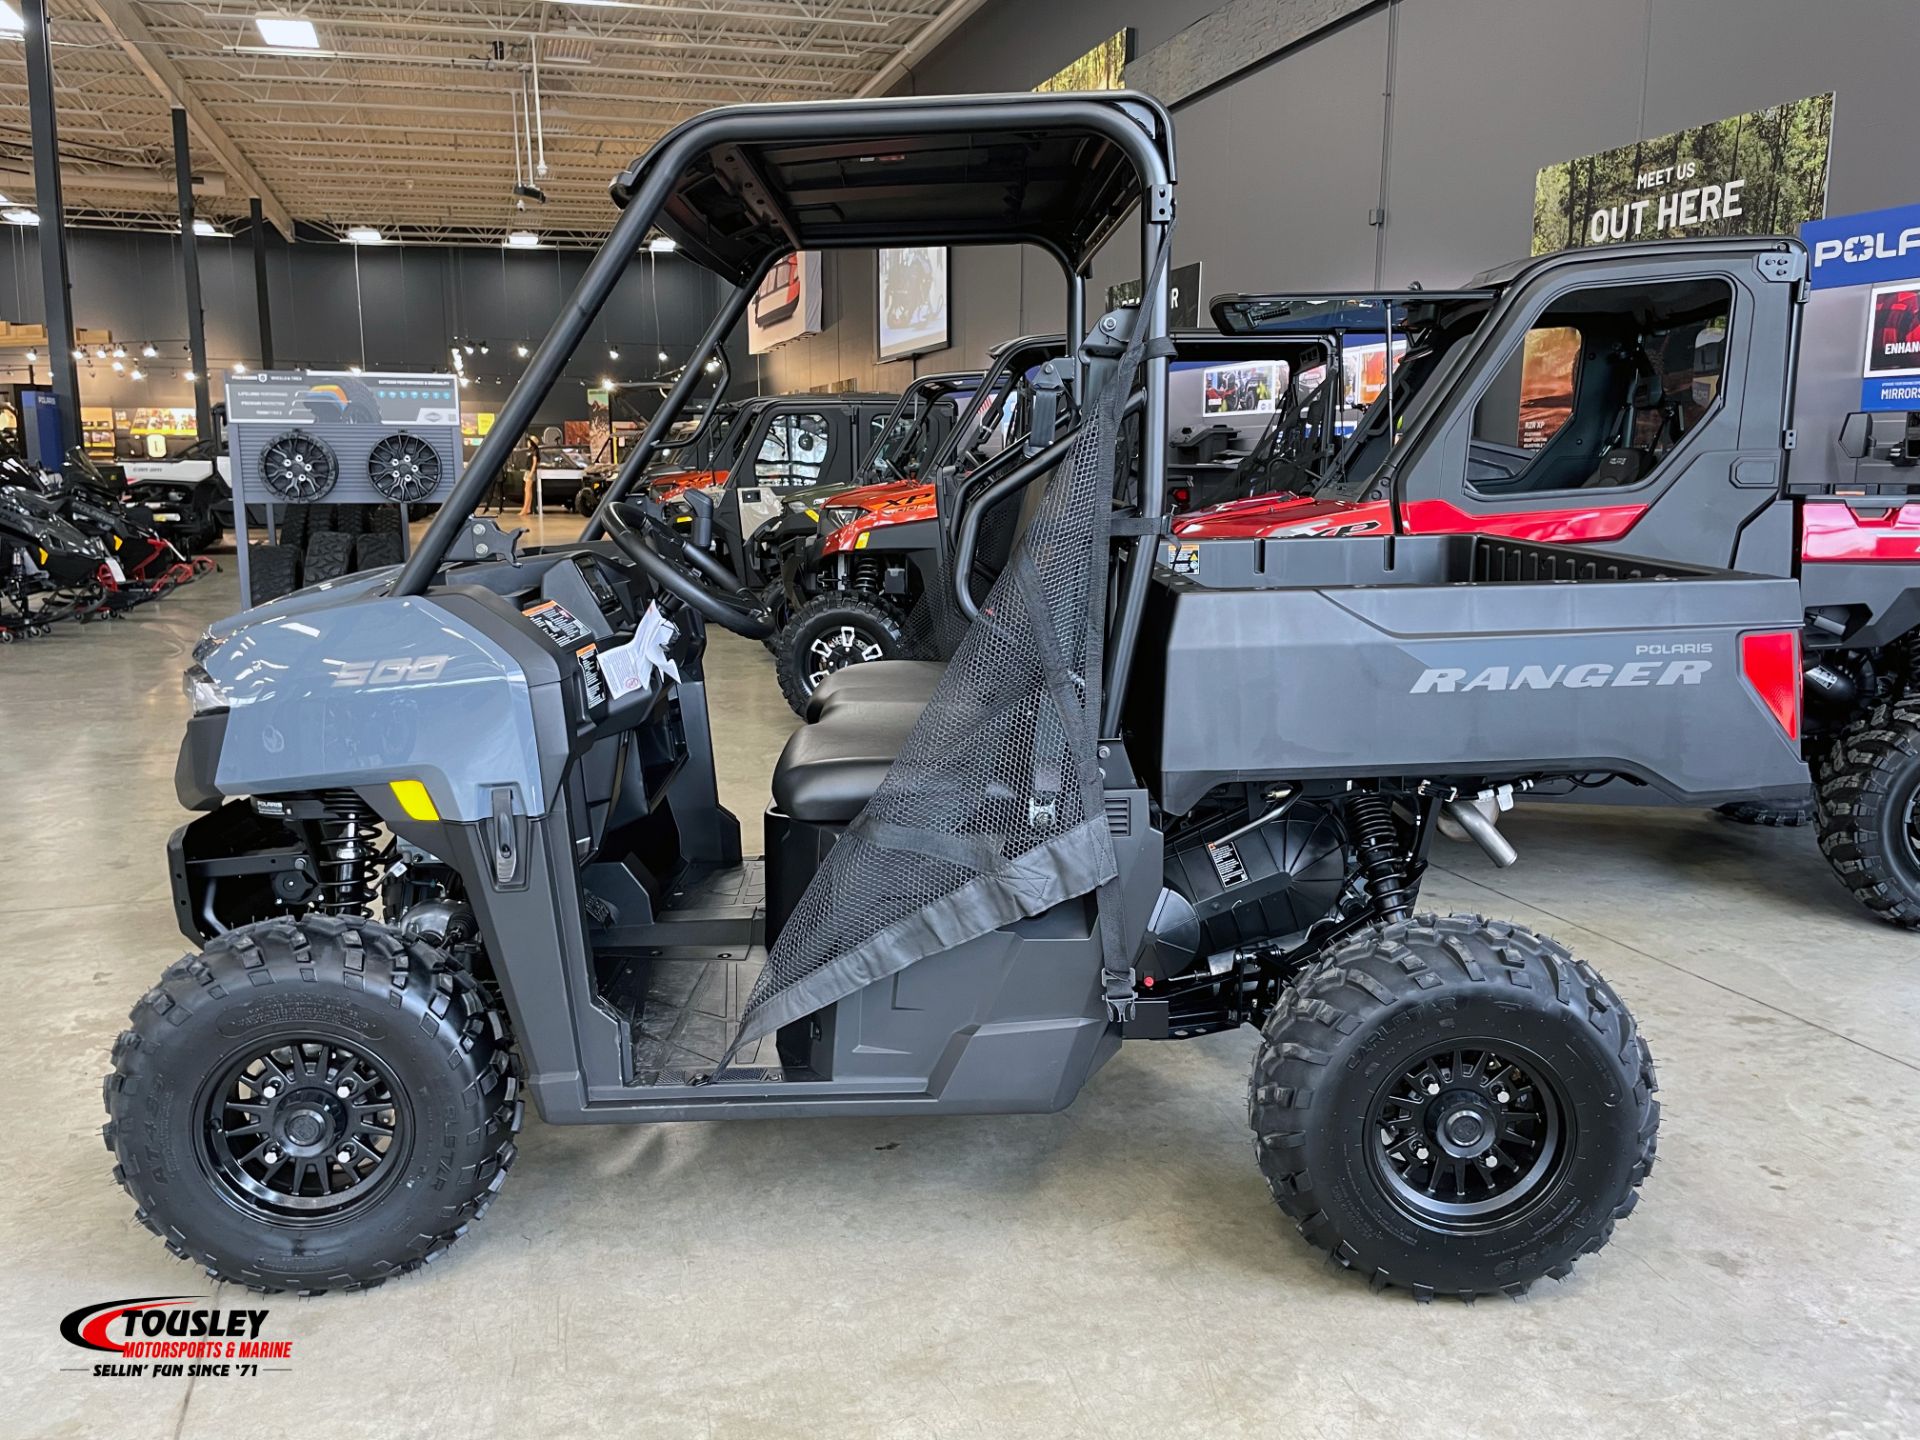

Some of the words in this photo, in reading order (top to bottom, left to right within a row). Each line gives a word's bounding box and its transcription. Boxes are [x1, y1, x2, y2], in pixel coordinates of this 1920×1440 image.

[1636, 166, 1675, 191] MEET
[1676, 162, 1696, 181] US
[1590, 200, 1650, 243] OUT
[1657, 179, 1745, 231] HERE
[1884, 340, 1920, 355] ENHAN
[880, 492, 932, 509] XP
[1635, 643, 1713, 656] POLARIS
[331, 654, 449, 688] 500
[1409, 660, 1713, 694] RANGER
